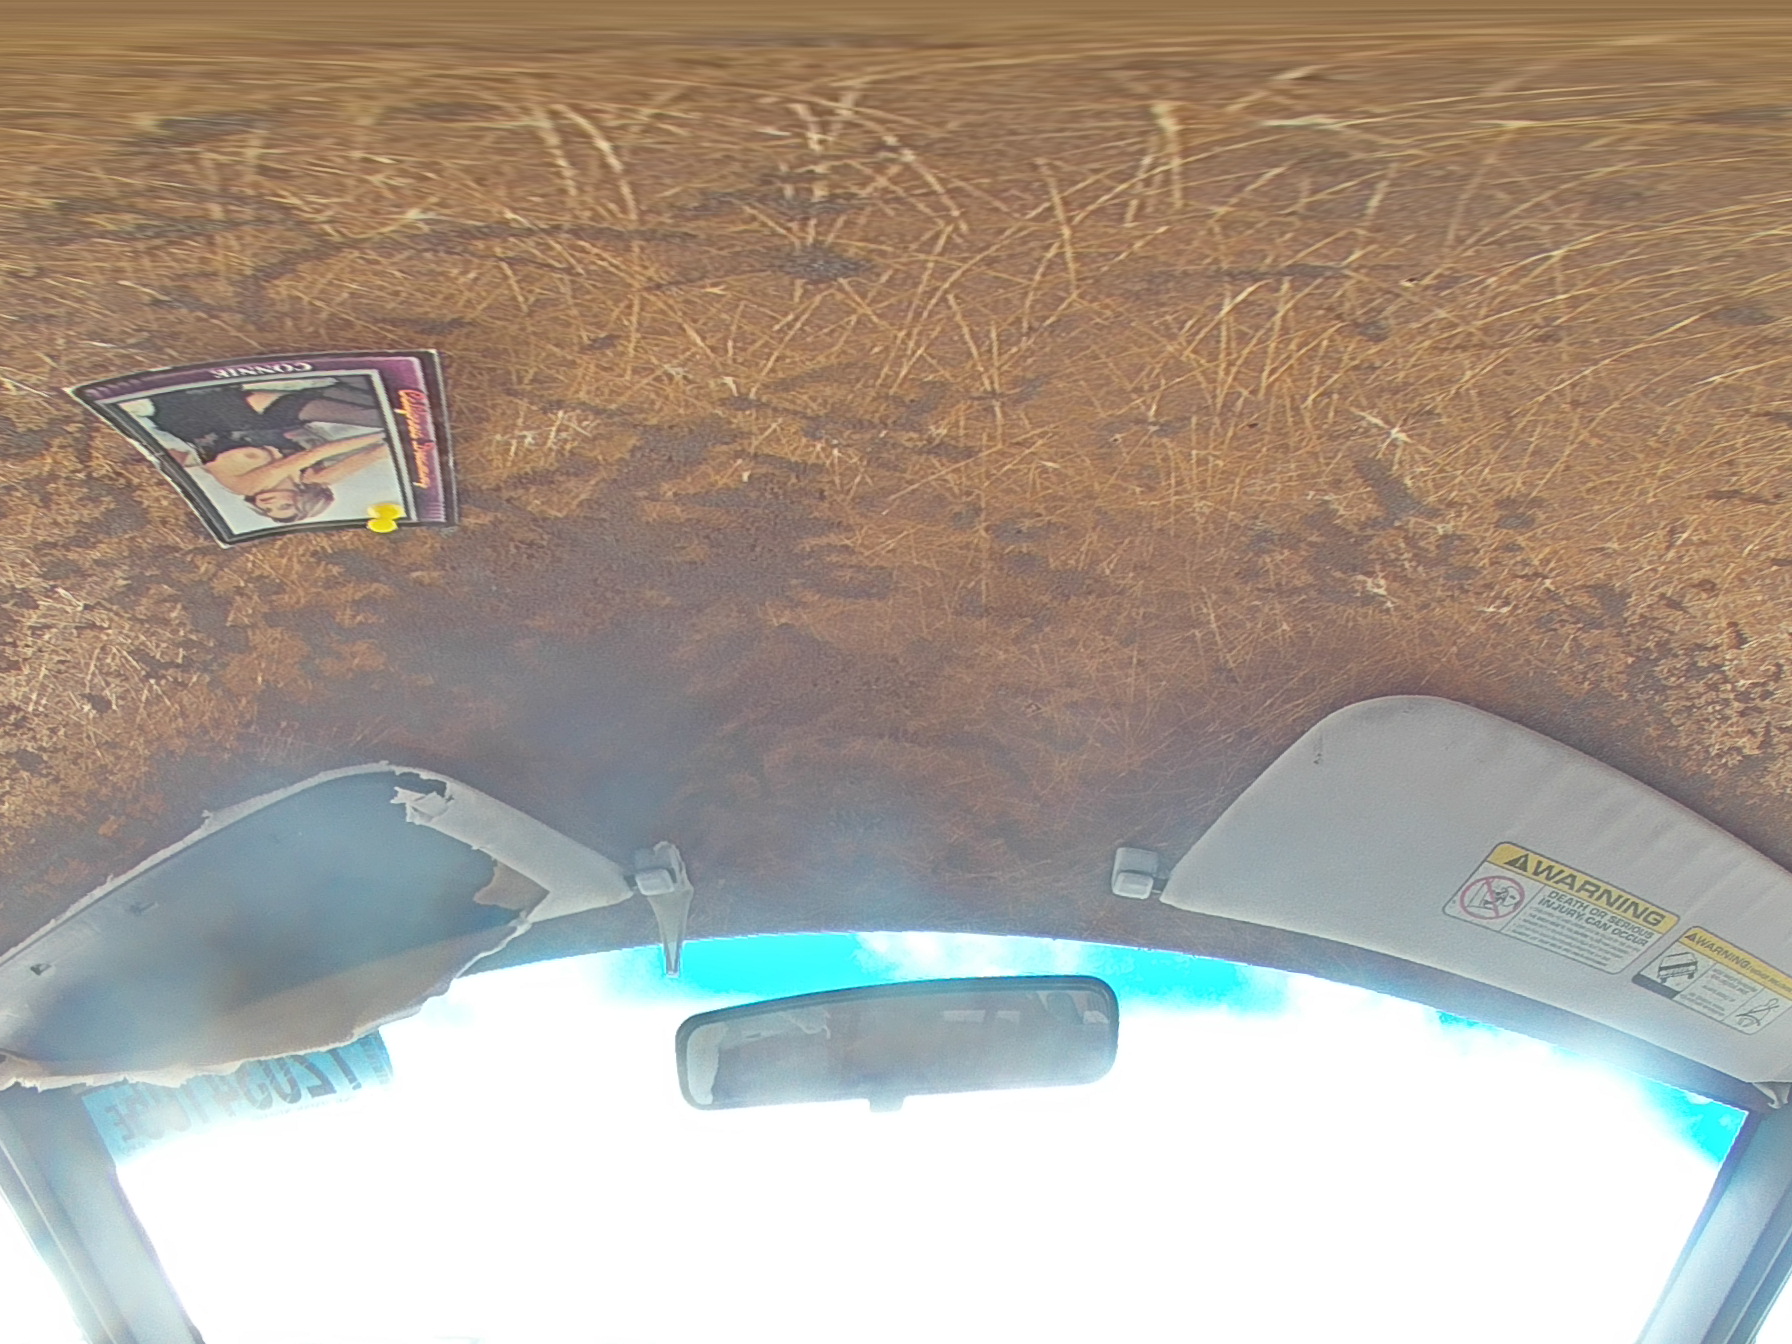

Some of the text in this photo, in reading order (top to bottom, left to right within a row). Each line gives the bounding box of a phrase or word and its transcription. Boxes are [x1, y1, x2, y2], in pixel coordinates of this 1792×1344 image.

[209, 362, 313, 380] CONNIE
[1532, 859, 1667, 928] WARNING
[1547, 890, 1655, 940] DEATH OR SERIOUS
[1585, 916, 1612, 932] CAN
[1611, 928, 1649, 947] OCCUR
